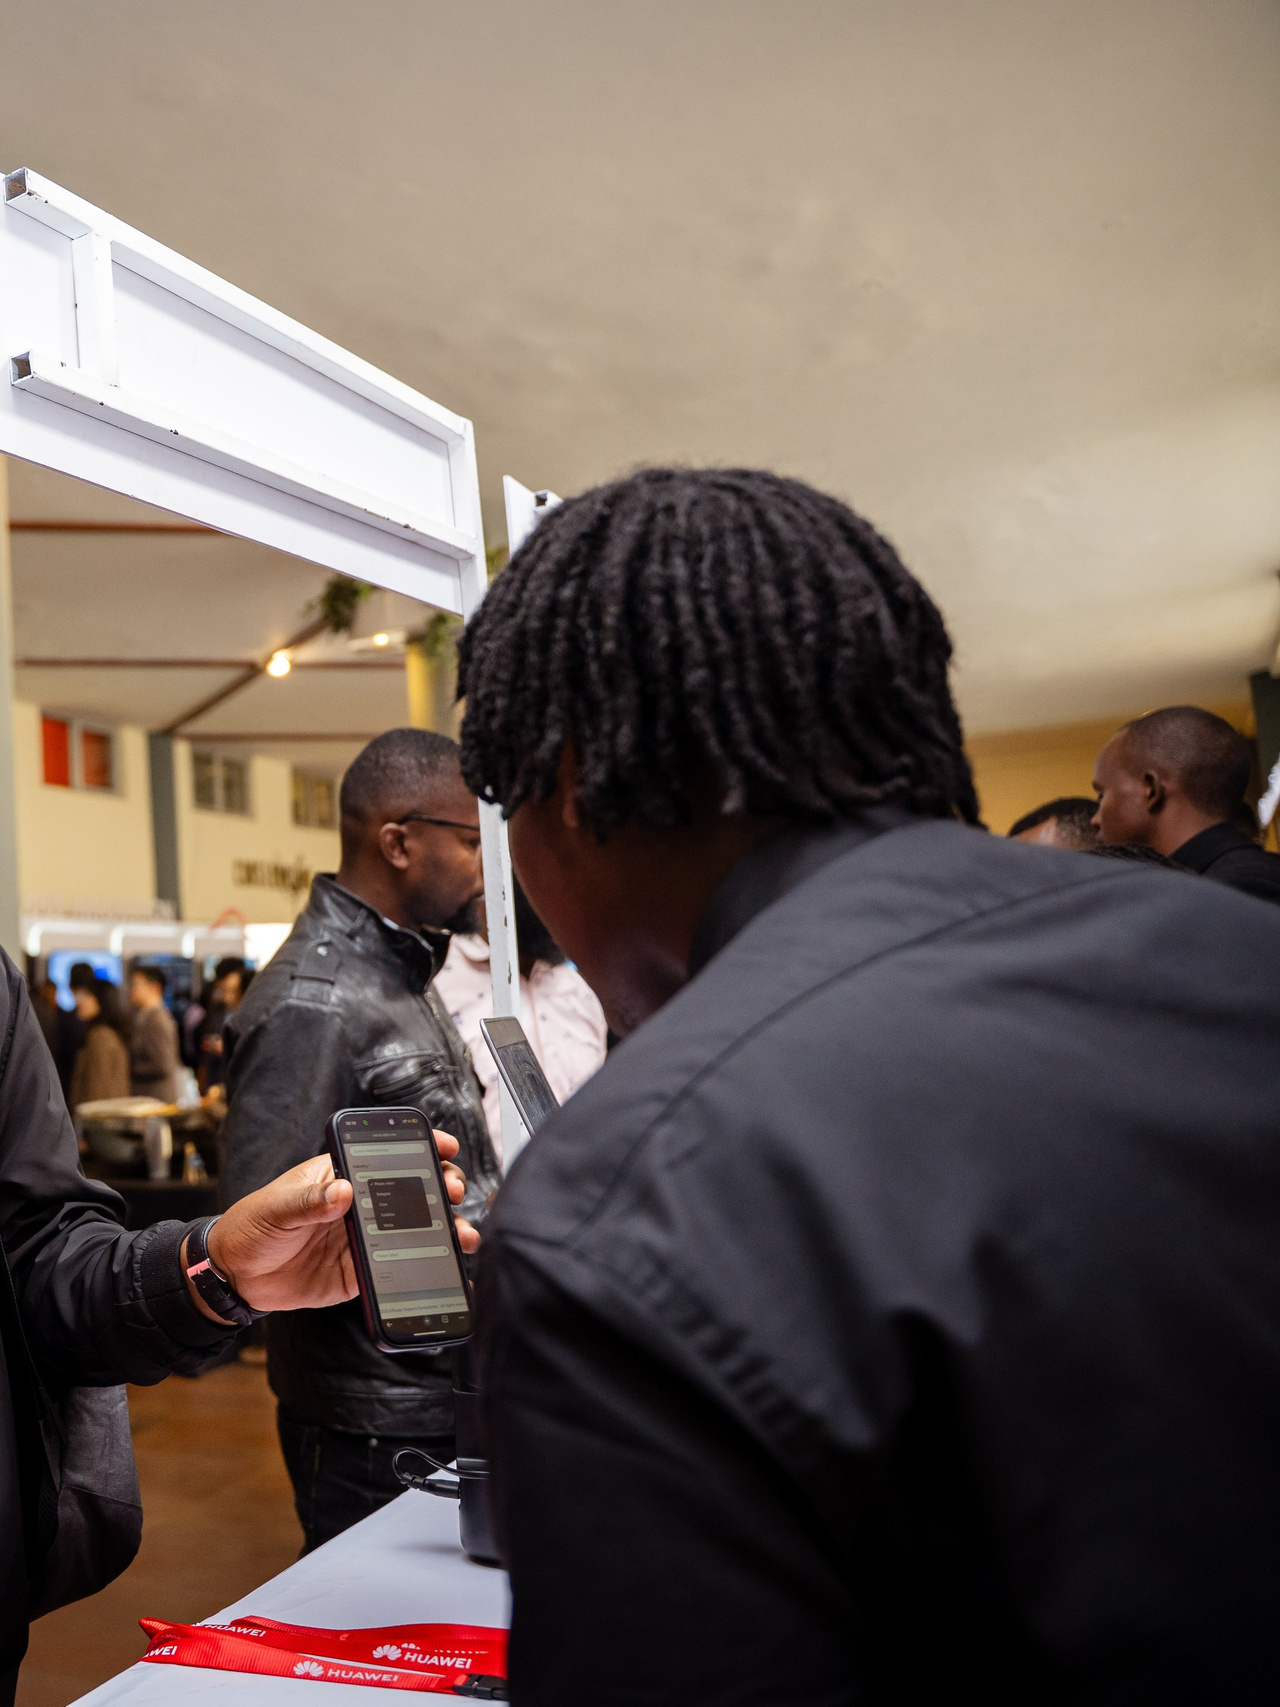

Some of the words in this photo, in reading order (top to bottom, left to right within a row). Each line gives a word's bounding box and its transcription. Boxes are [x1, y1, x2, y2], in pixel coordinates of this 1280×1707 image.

[144, 1645, 178, 1658] WEI
[403, 1651, 472, 1669] HUAWEI
[327, 1668, 399, 1682] HUAWEI
